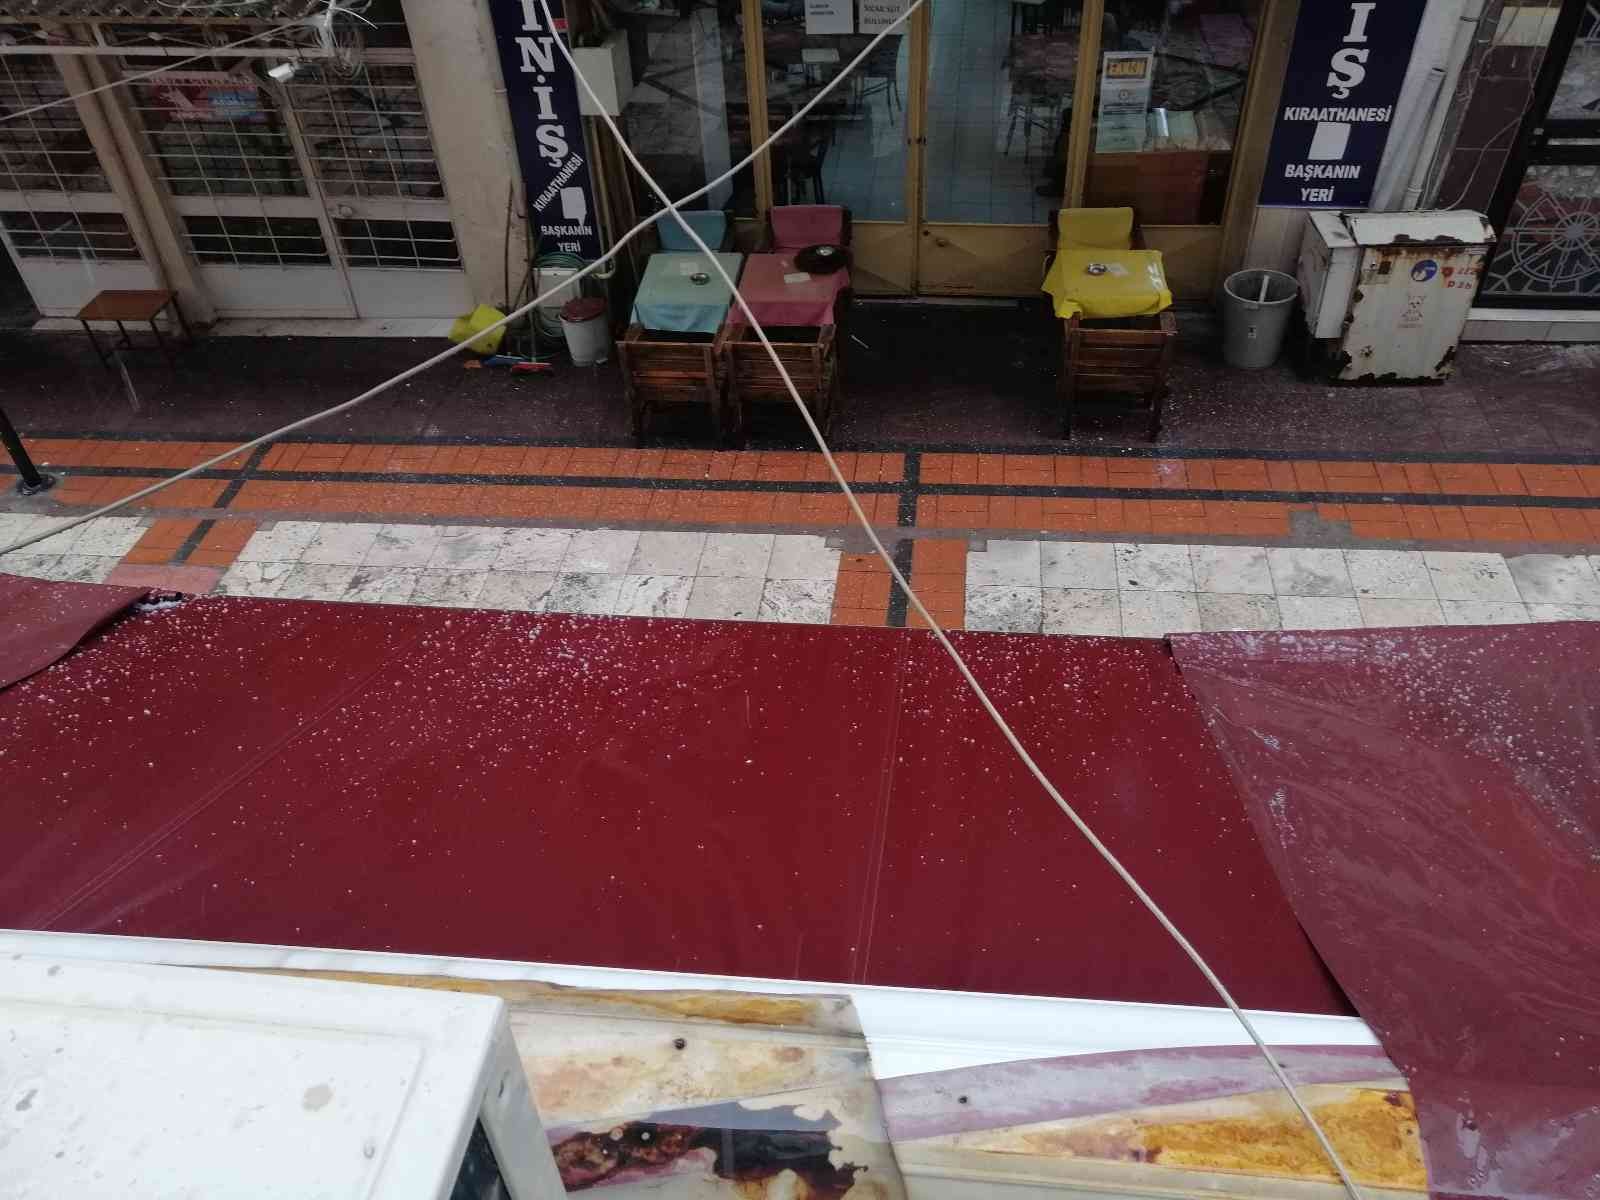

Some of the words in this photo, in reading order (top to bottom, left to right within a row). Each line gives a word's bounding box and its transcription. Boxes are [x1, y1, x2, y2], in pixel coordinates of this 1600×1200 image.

[1284, 105, 1392, 122] KIRAATHANESİ
[1285, 164, 1361, 181] BAŞKANIN
[533, 153, 584, 212] KIRAATHANESİ
[1301, 186, 1335, 202] YERİ
[557, 240, 581, 252] YERİ
